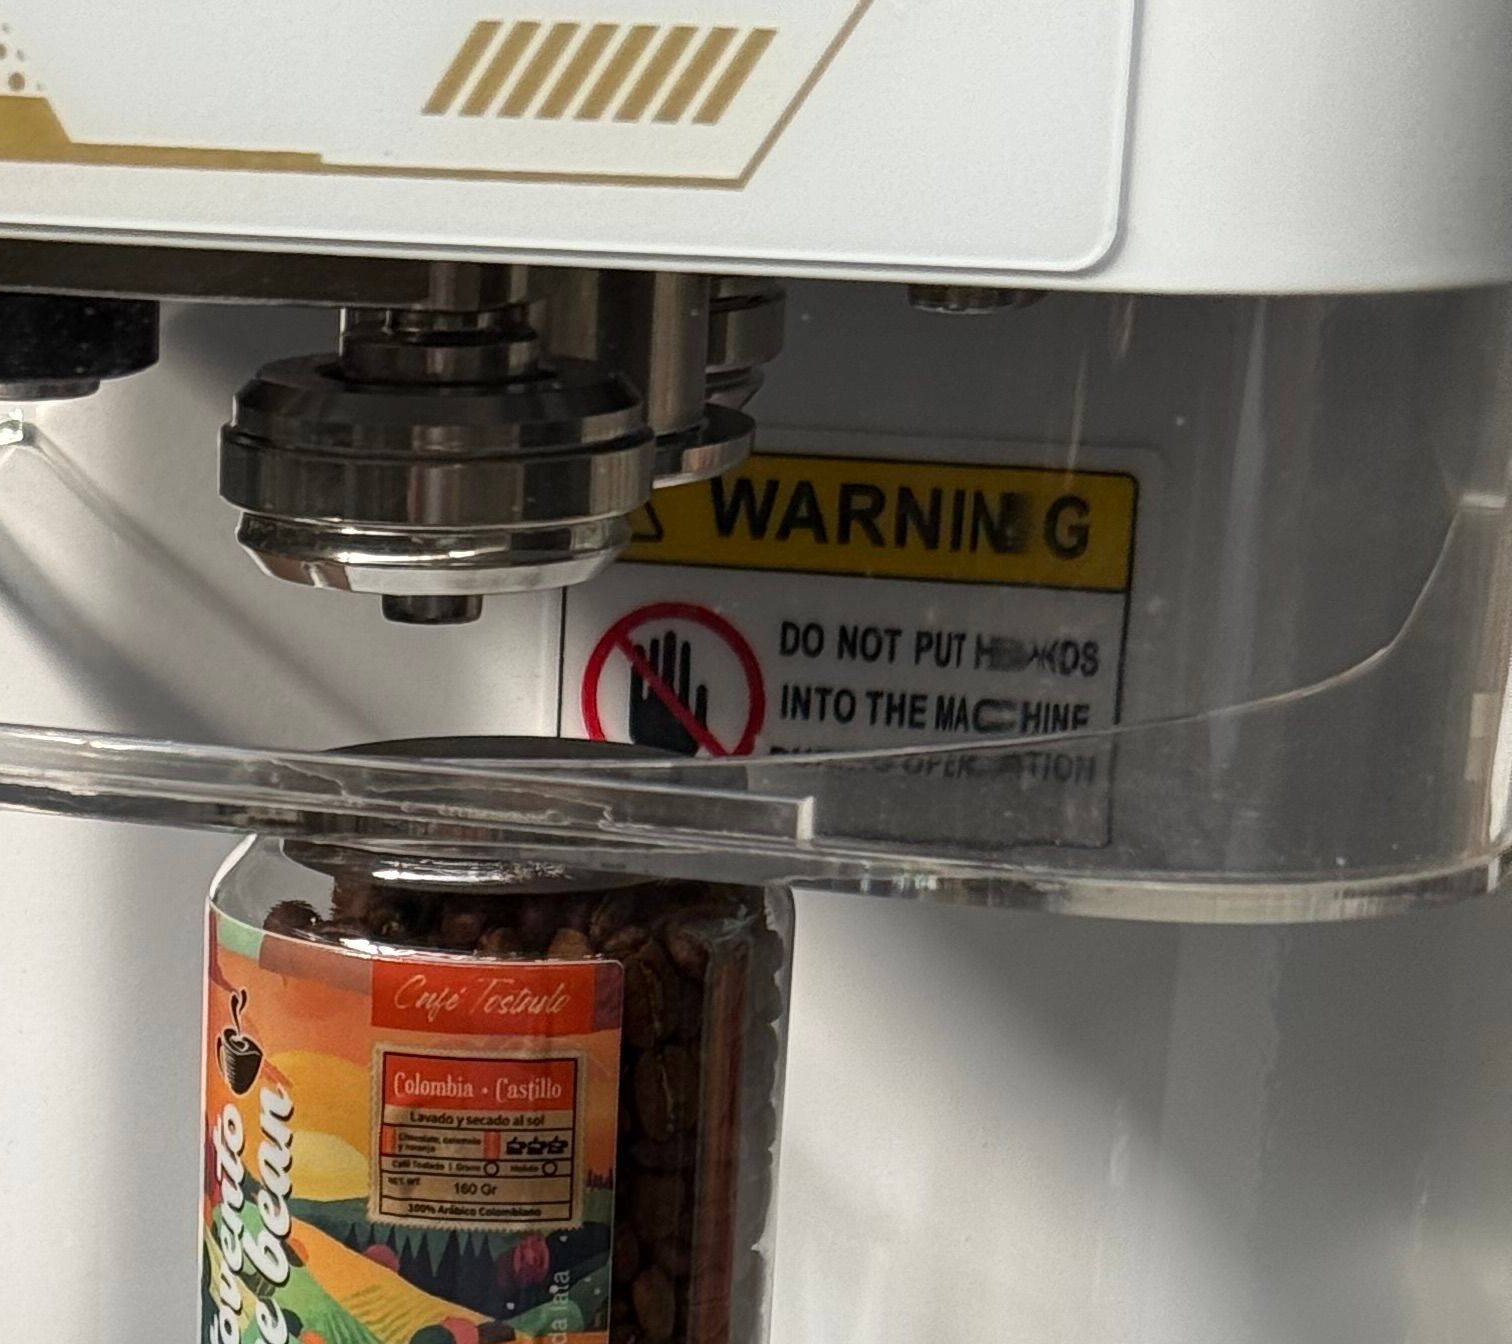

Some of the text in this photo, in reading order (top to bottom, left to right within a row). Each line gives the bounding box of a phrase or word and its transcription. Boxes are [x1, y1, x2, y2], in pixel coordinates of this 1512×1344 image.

[711, 476, 1091, 560] WARNING
[779, 620, 824, 660] DO
[837, 625, 902, 664] NOT
[914, 630, 967, 669] PUT
[780, 683, 856, 725] INTO
[865, 690, 928, 730] THE
[394, 1072, 562, 1103] Colombia Castillo
[410, 1111, 545, 1128] Lavado y secado al sol
[239, 1083, 294, 1286] bean
[454, 1182, 497, 1196] 160 Gr
